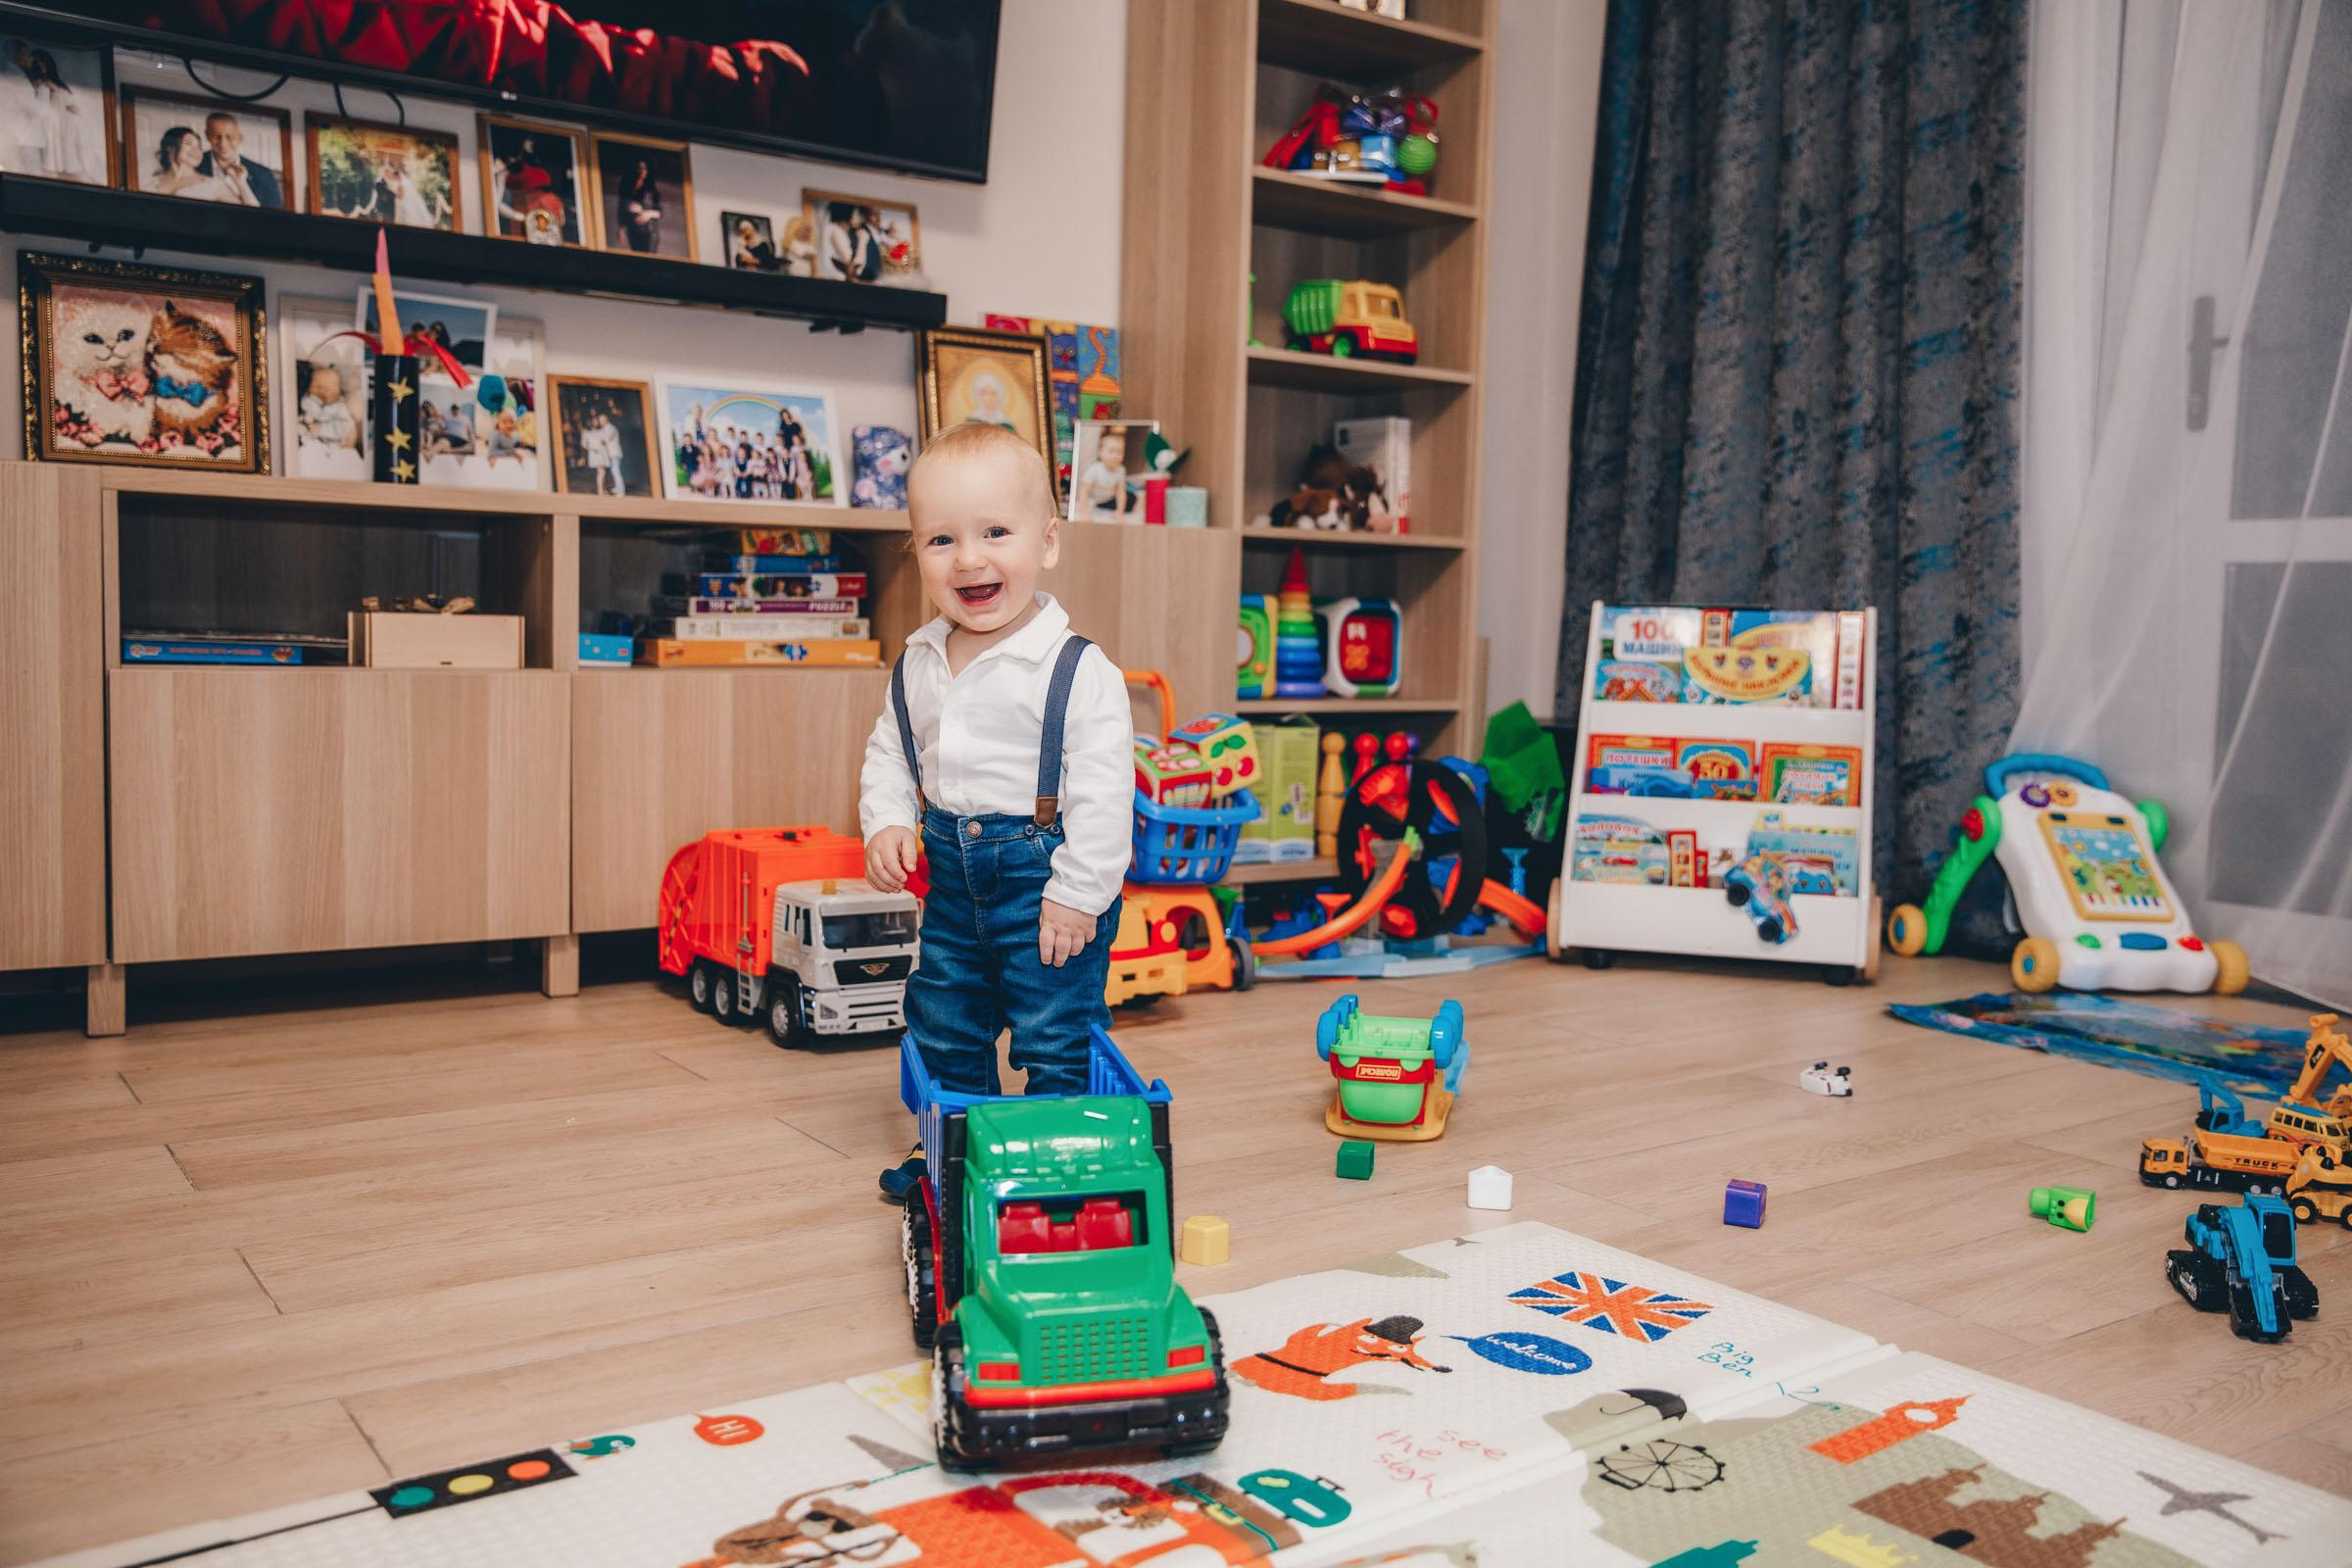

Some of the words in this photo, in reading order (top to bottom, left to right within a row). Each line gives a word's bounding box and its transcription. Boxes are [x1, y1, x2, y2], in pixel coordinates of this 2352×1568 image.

[2234, 1157, 2278, 1168] TRUCK
[1486, 1336, 1577, 1370] welcome
[1697, 1352, 1752, 1378] Ben
[1711, 1342, 1754, 1365] Big
[1376, 1429, 1443, 1462] the
